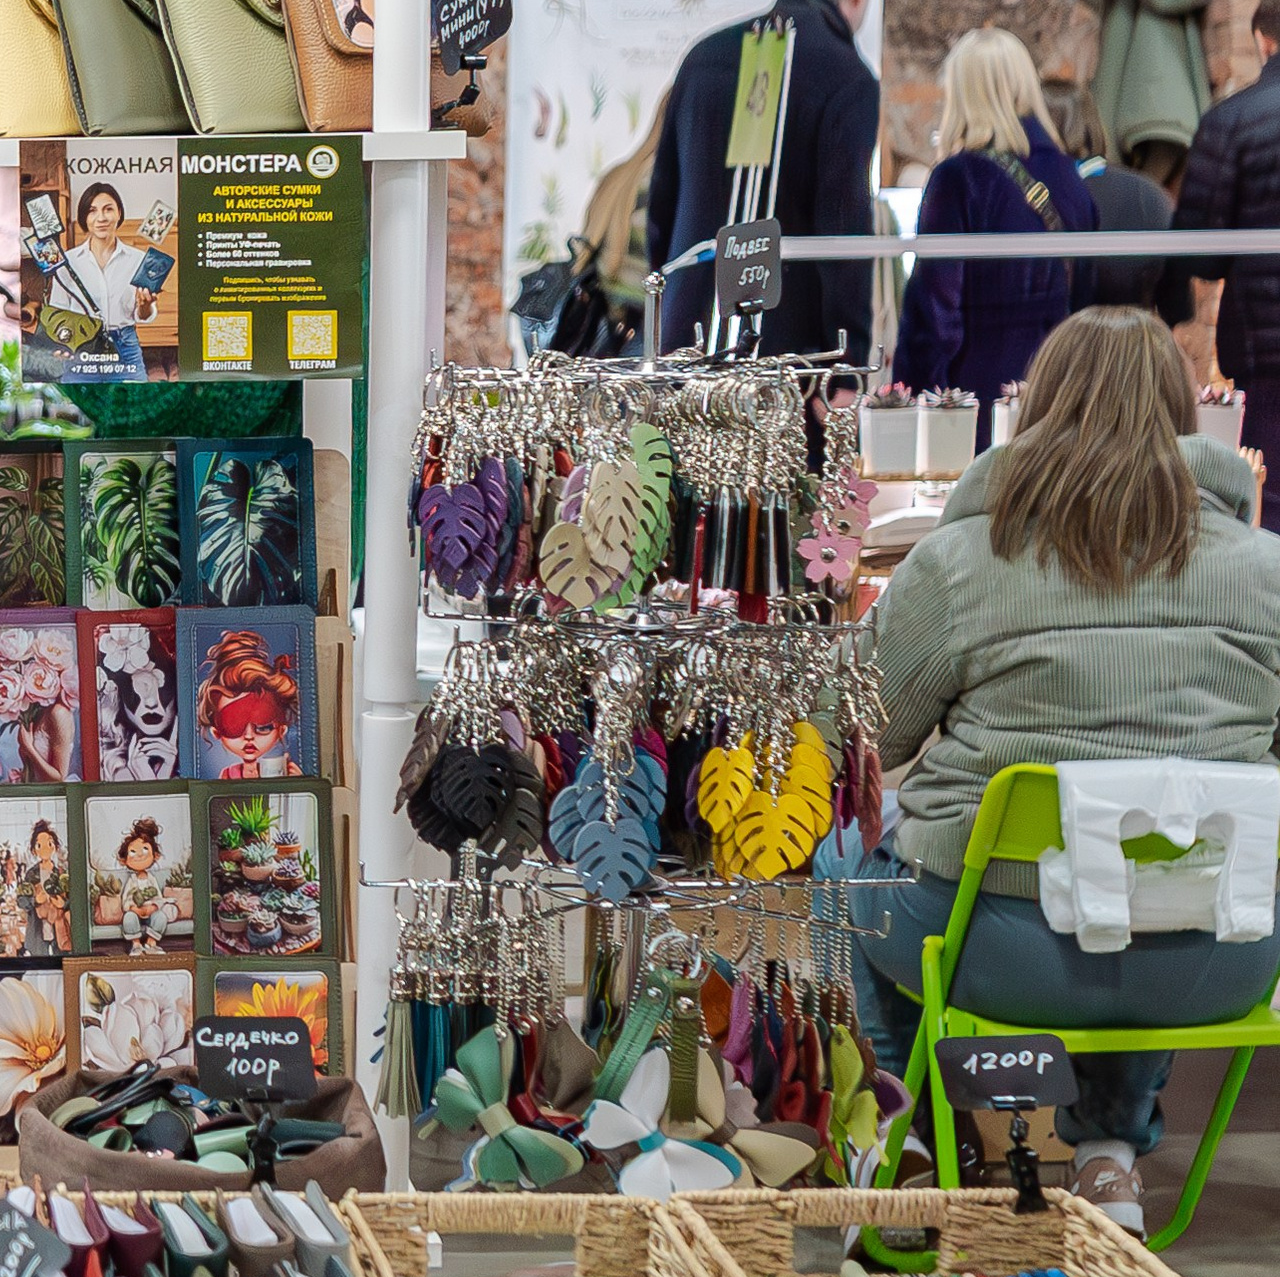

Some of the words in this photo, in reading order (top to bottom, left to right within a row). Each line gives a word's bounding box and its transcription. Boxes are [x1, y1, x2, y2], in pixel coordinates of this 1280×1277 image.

[66, 156, 173, 174] КОЖАНАЯ
[181, 154, 302, 174] МОНСТЕРА
[213, 185, 280, 196] АВТОРСКИЕ
[282, 184, 321, 195] СУМКИ
[226, 199, 234, 209] И
[236, 198, 313, 209] АКСЕССУАРЫ
[197, 213, 213, 223] ИЗ
[215, 210, 297, 222] НАТУРАЛЬНОЙ
[300, 211, 333, 222] КОЖИ
[80, 352, 119, 362] Оксана
[126, 365, 137, 373] 12
[203, 361, 252, 370] ВКОНТАКТЕ
[289, 360, 336, 369] ТЕЛЕГРАМ
